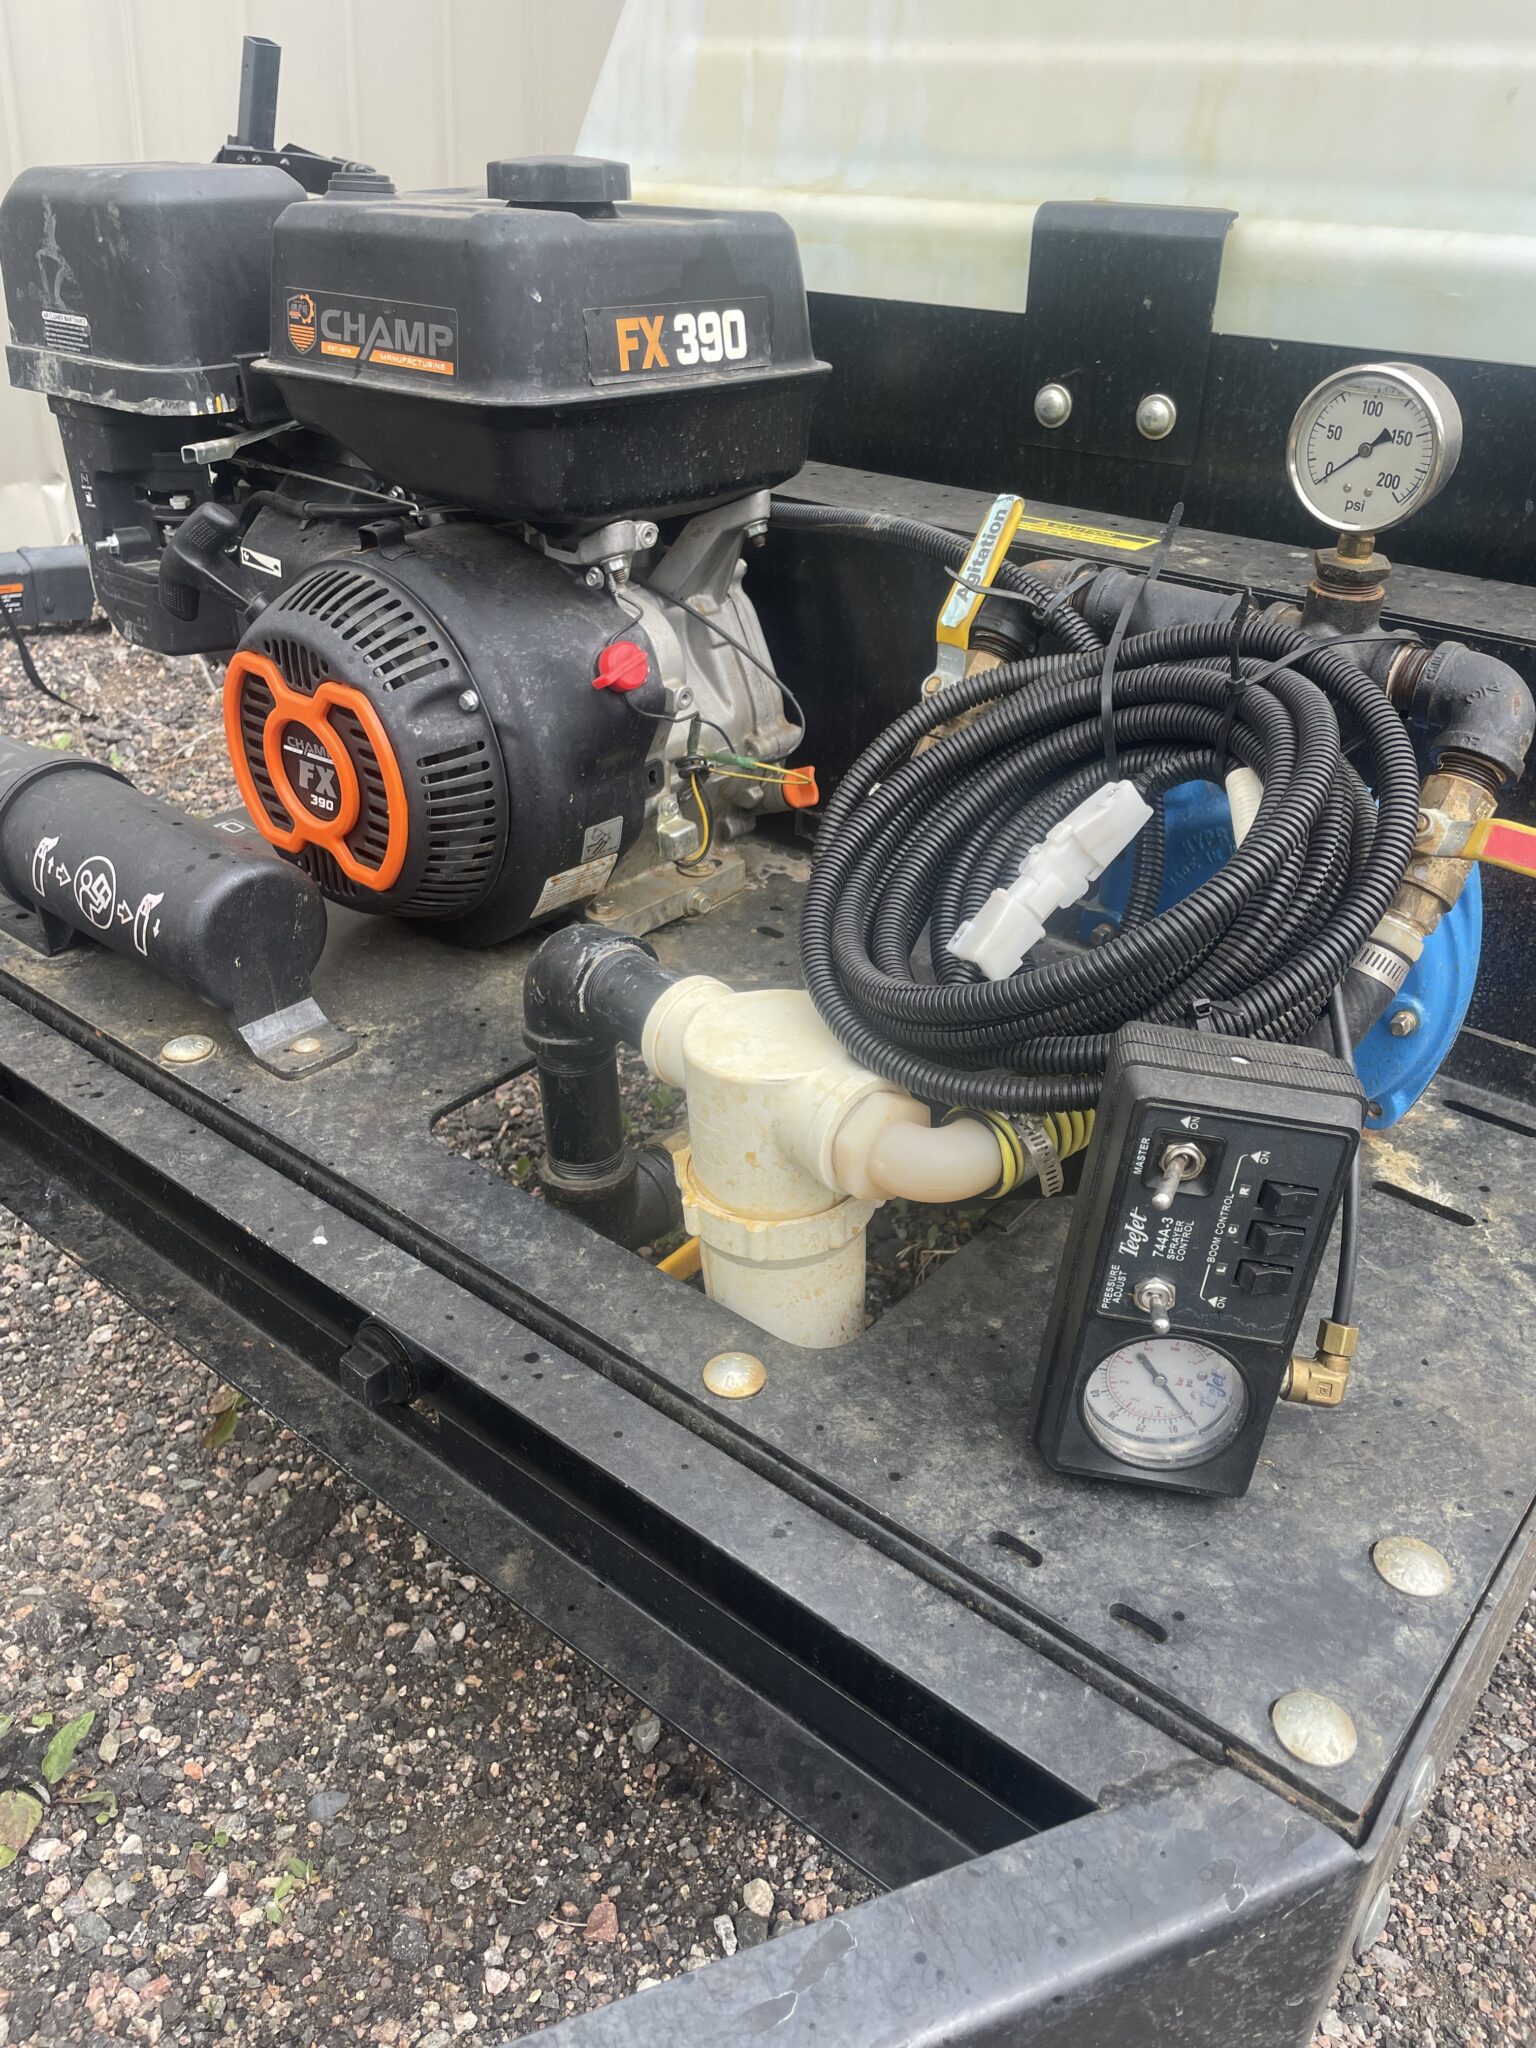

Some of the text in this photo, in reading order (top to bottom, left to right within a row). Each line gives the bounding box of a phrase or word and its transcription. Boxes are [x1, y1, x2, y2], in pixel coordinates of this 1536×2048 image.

[320, 309, 454, 360] CHAMP
[616, 309, 747, 372] FX 390
[379, 353, 446, 371] MANUFACTURING
[1362, 399, 1384, 417] 100
[1327, 425, 1343, 441] 50
[1391, 428, 1413, 446] 150
[1376, 472, 1400, 489] 200
[1344, 500, 1366, 512] psi
[956, 509, 1008, 602] Agitation
[287, 736, 331, 758] CHAM
[299, 759, 338, 799] FX
[310, 794, 334, 811] 390
[1189, 1116, 1201, 1130] ON
[1133, 1137, 1151, 1175] MASTER
[1259, 1150, 1271, 1165] ON
[1239, 1187, 1250, 1196] R
[1118, 1206, 1148, 1257] TeeJet
[1152, 1216, 1174, 1257] 744A-3
[1207, 1193, 1235, 1263] BOOM CONTROL
[1228, 1226, 1238, 1235] C
[1166, 1220, 1185, 1260] SPRAYER
[1176, 1220, 1195, 1262] CONTROL
[1217, 1266, 1227, 1274] L
[1101, 1264, 1121, 1309] PRESSURE
[1111, 1270, 1128, 1304] ADJUST
[1216, 1296, 1228, 1309] ON
[1135, 1423, 1147, 1433] 20
[1168, 1424, 1179, 1434] 10
